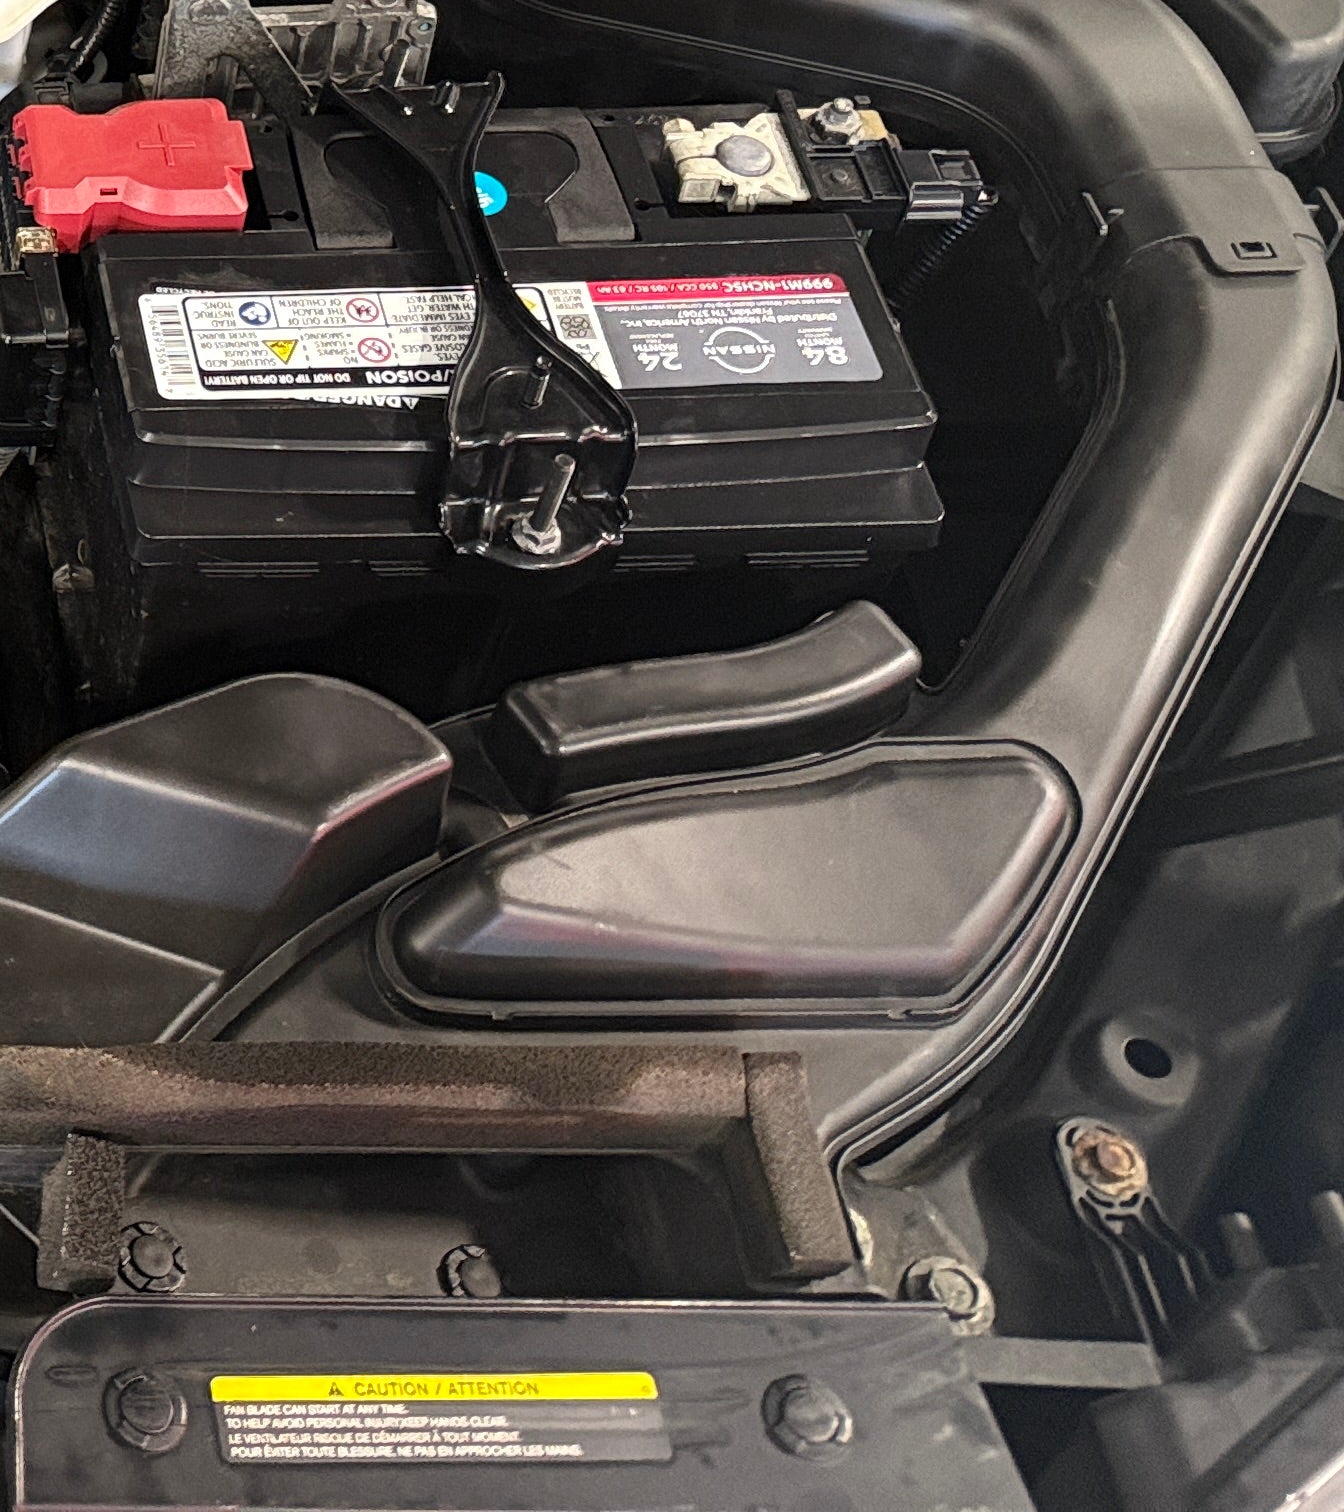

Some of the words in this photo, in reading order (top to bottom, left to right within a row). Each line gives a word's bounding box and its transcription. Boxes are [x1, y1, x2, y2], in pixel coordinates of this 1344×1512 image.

[677, 283, 698, 291] CCA
[429, 294, 452, 303] HELP
[279, 299, 326, 308] CHILDREN
[292, 308, 323, 316] REACH
[407, 305, 424, 313] GET
[448, 312, 471, 321] EYES
[724, 316, 761, 324] Nissan
[761, 315, 776, 323] by
[288, 318, 299, 326] OF
[692, 317, 723, 326] North
[797, 337, 842, 346] MONTH
[402, 345, 432, 353] GASES
[632, 343, 679, 352] MONTH
[702, 344, 776, 356] NISSAN
[802, 346, 848, 365] 84
[638, 352, 682, 371] 24
[203, 375, 249, 386] BATTERY!
[249, 375, 277, 385] OPEN
[278, 374, 294, 384] OR
[295, 374, 311, 383] TIP
[312, 374, 333, 383] NOT
[335, 373, 351, 383] DO
[354, 1381, 428, 1396] CAUTION
[448, 1381, 539, 1396] ATTENTION
[223, 1404, 245, 1415] FAN
[247, 1404, 282, 1415] BLADE
[283, 1404, 306, 1415] CAN
[307, 1404, 340, 1415] START
[342, 1404, 356, 1414] AT
[357, 1403, 379, 1414] ANY
[226, 1418, 241, 1429] TO
[243, 1418, 270, 1429] HELP
[272, 1418, 305, 1429] AVOID
[305, 1418, 363, 1429] PERSONAL
[430, 1416, 469, 1428] HANDS
[229, 1433, 242, 1444] LE
[313, 1432, 353, 1444] RISQUE
[355, 1432, 371, 1443] DE
[442, 1431, 470, 1443] TOUT
[230, 1446, 262, 1458] POUR
[302, 1446, 337, 1457] TOUTE
[397, 1446, 413, 1457] NE
[414, 1446, 436, 1457] PAS
[455, 1445, 523, 1457] APPROCHER
[524, 1445, 545, 1456] LES
